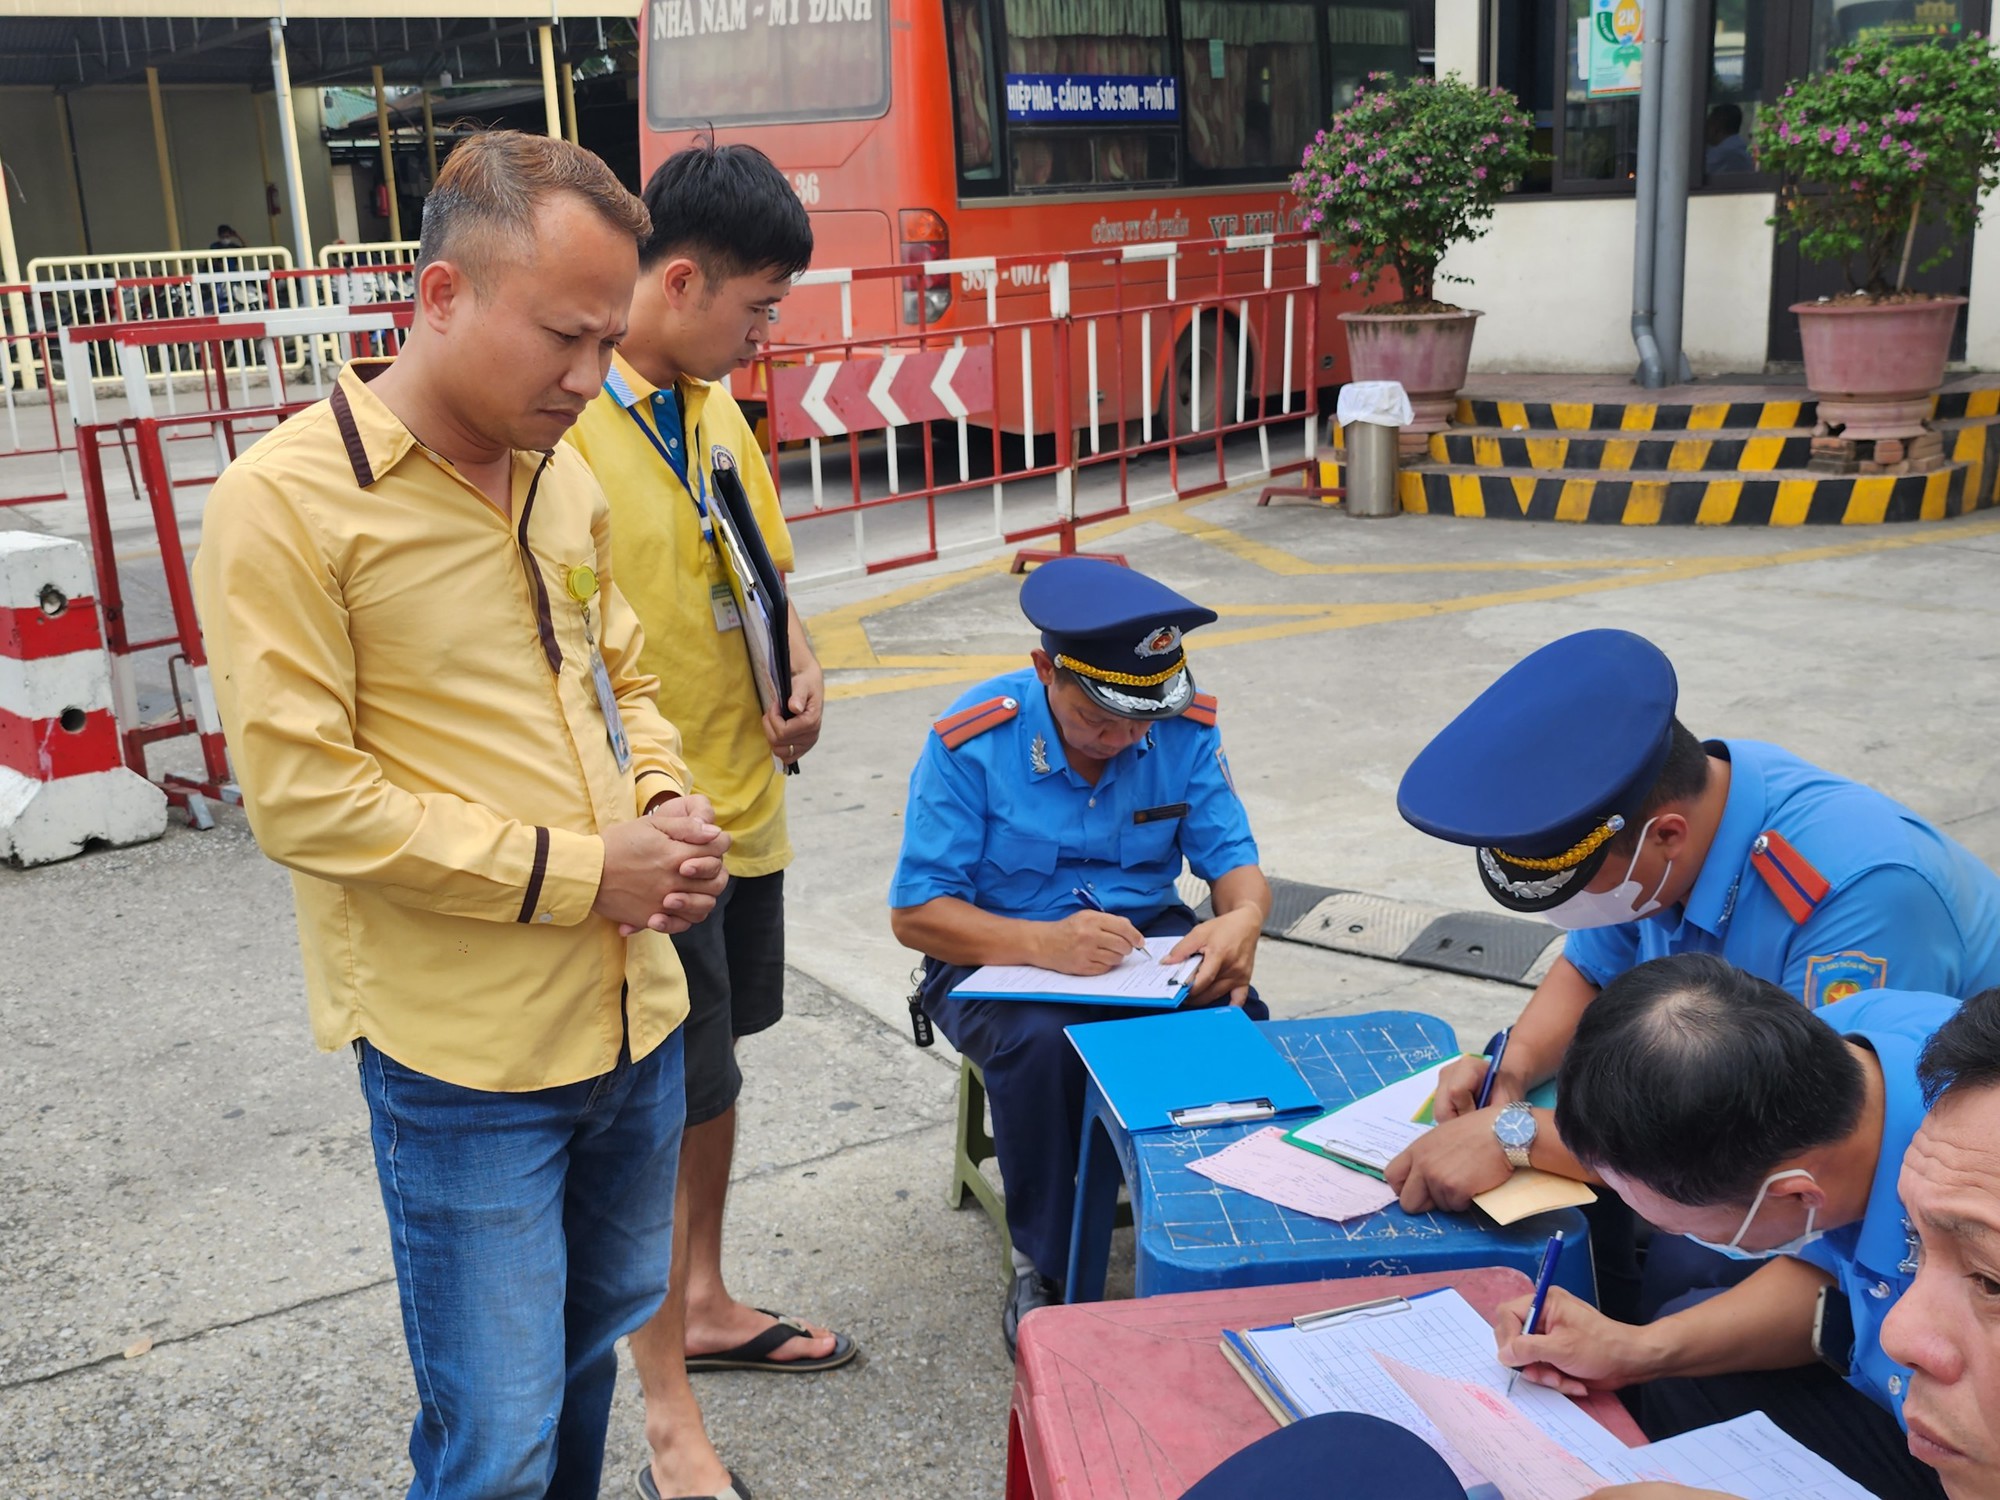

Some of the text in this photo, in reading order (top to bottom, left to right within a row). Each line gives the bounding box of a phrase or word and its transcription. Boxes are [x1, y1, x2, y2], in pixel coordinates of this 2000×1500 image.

[699, 0, 747, 34] NAM
[1098, 81, 1118, 111] SÓC
[784, 172, 820, 205] 36
[1092, 216, 1125, 243] CÔNG
[1125, 220, 1141, 240] TY
